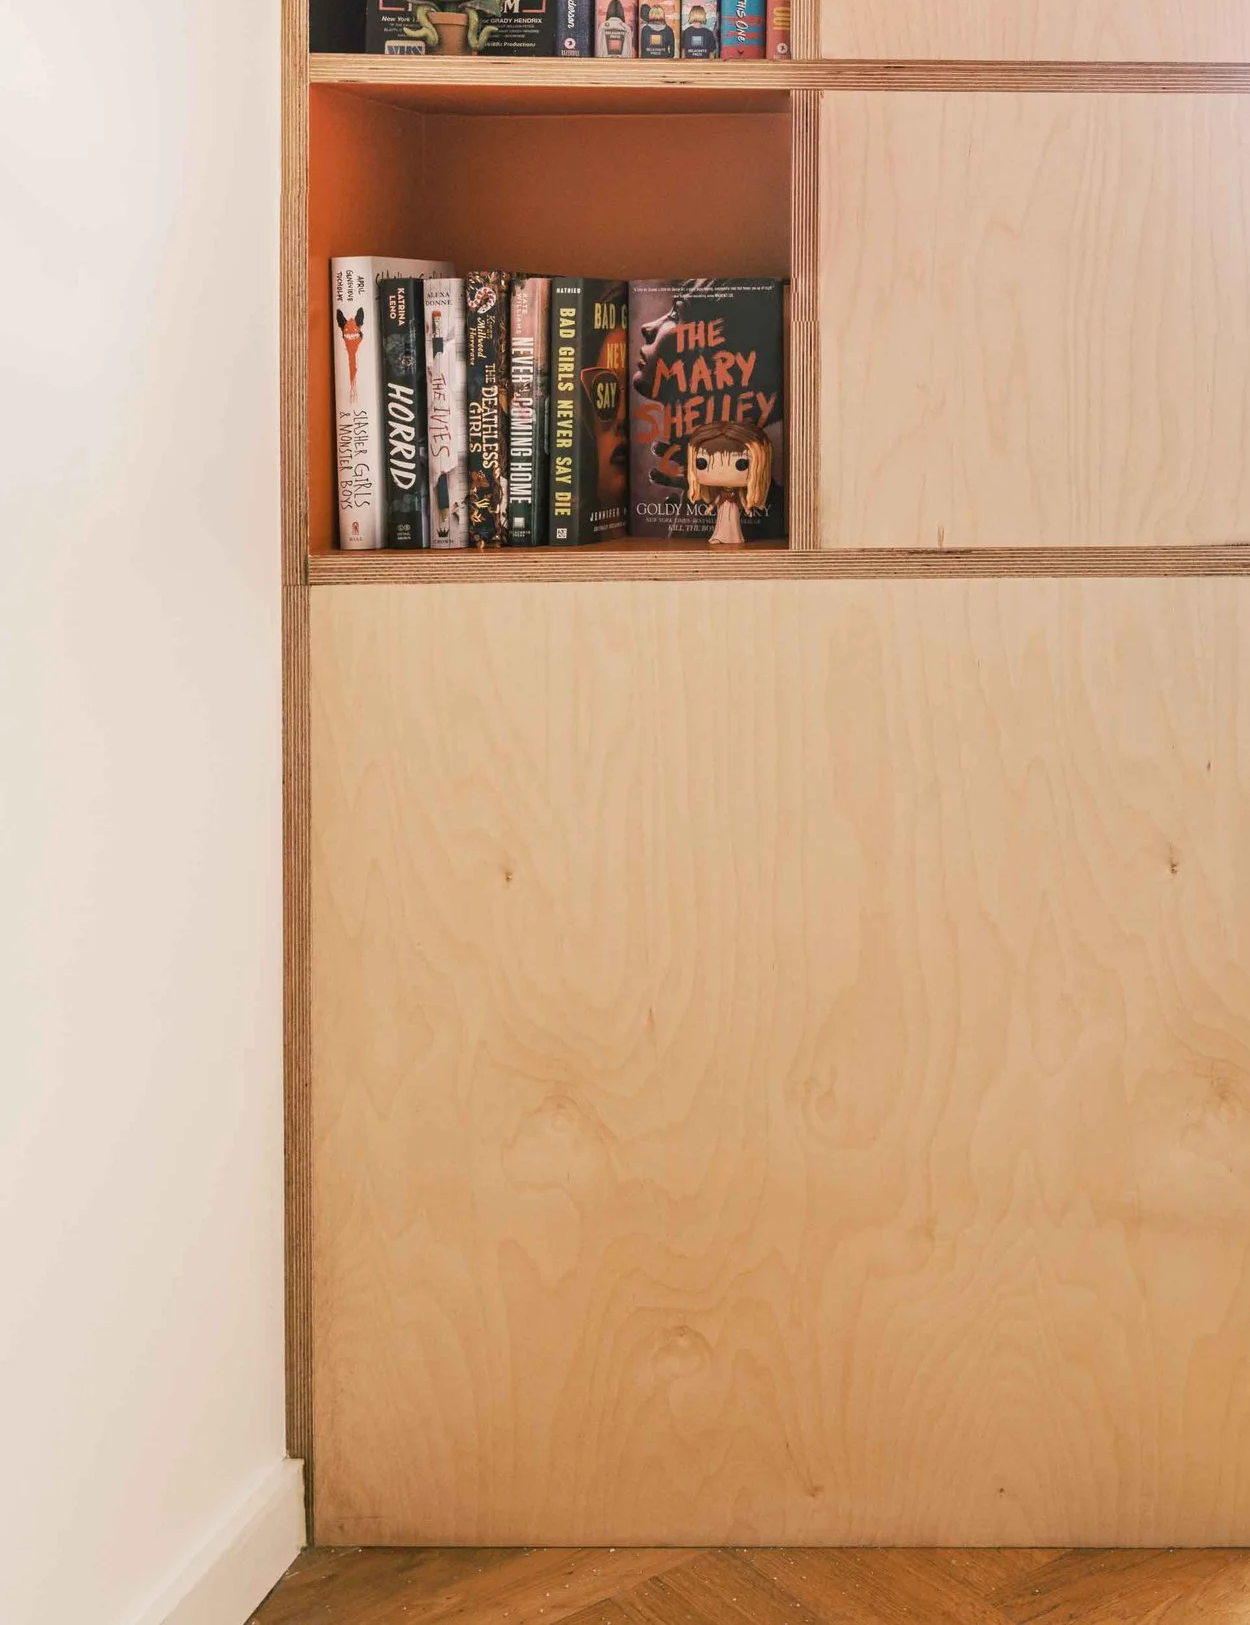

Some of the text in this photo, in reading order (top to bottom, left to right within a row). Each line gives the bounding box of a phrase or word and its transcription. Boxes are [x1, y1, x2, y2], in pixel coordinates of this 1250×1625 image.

[389, 295, 397, 320] LENO
[397, 287, 406, 326] KATRINA
[594, 302, 616, 330] BAD
[511, 337, 534, 383] NEVER
[669, 317, 726, 354] THE
[596, 381, 617, 410] SAY
[652, 349, 757, 399] MARY
[387, 382, 417, 490] HORRID
[429, 373, 452, 458] THE IVES
[469, 401, 482, 454] GIRLS
[481, 362, 499, 470] THE DEATHLESS
[510, 397, 534, 457] COMING
[554, 307, 576, 516] BAD GIRLS NEVER SAY DIE
[632, 389, 778, 445] SHELLEY
[338, 424, 353, 511] MONSTER BOYS
[353, 410, 372, 508] SLASHER GIRLS
[509, 462, 532, 504] HOME
[636, 503, 683, 516] GOLDY
